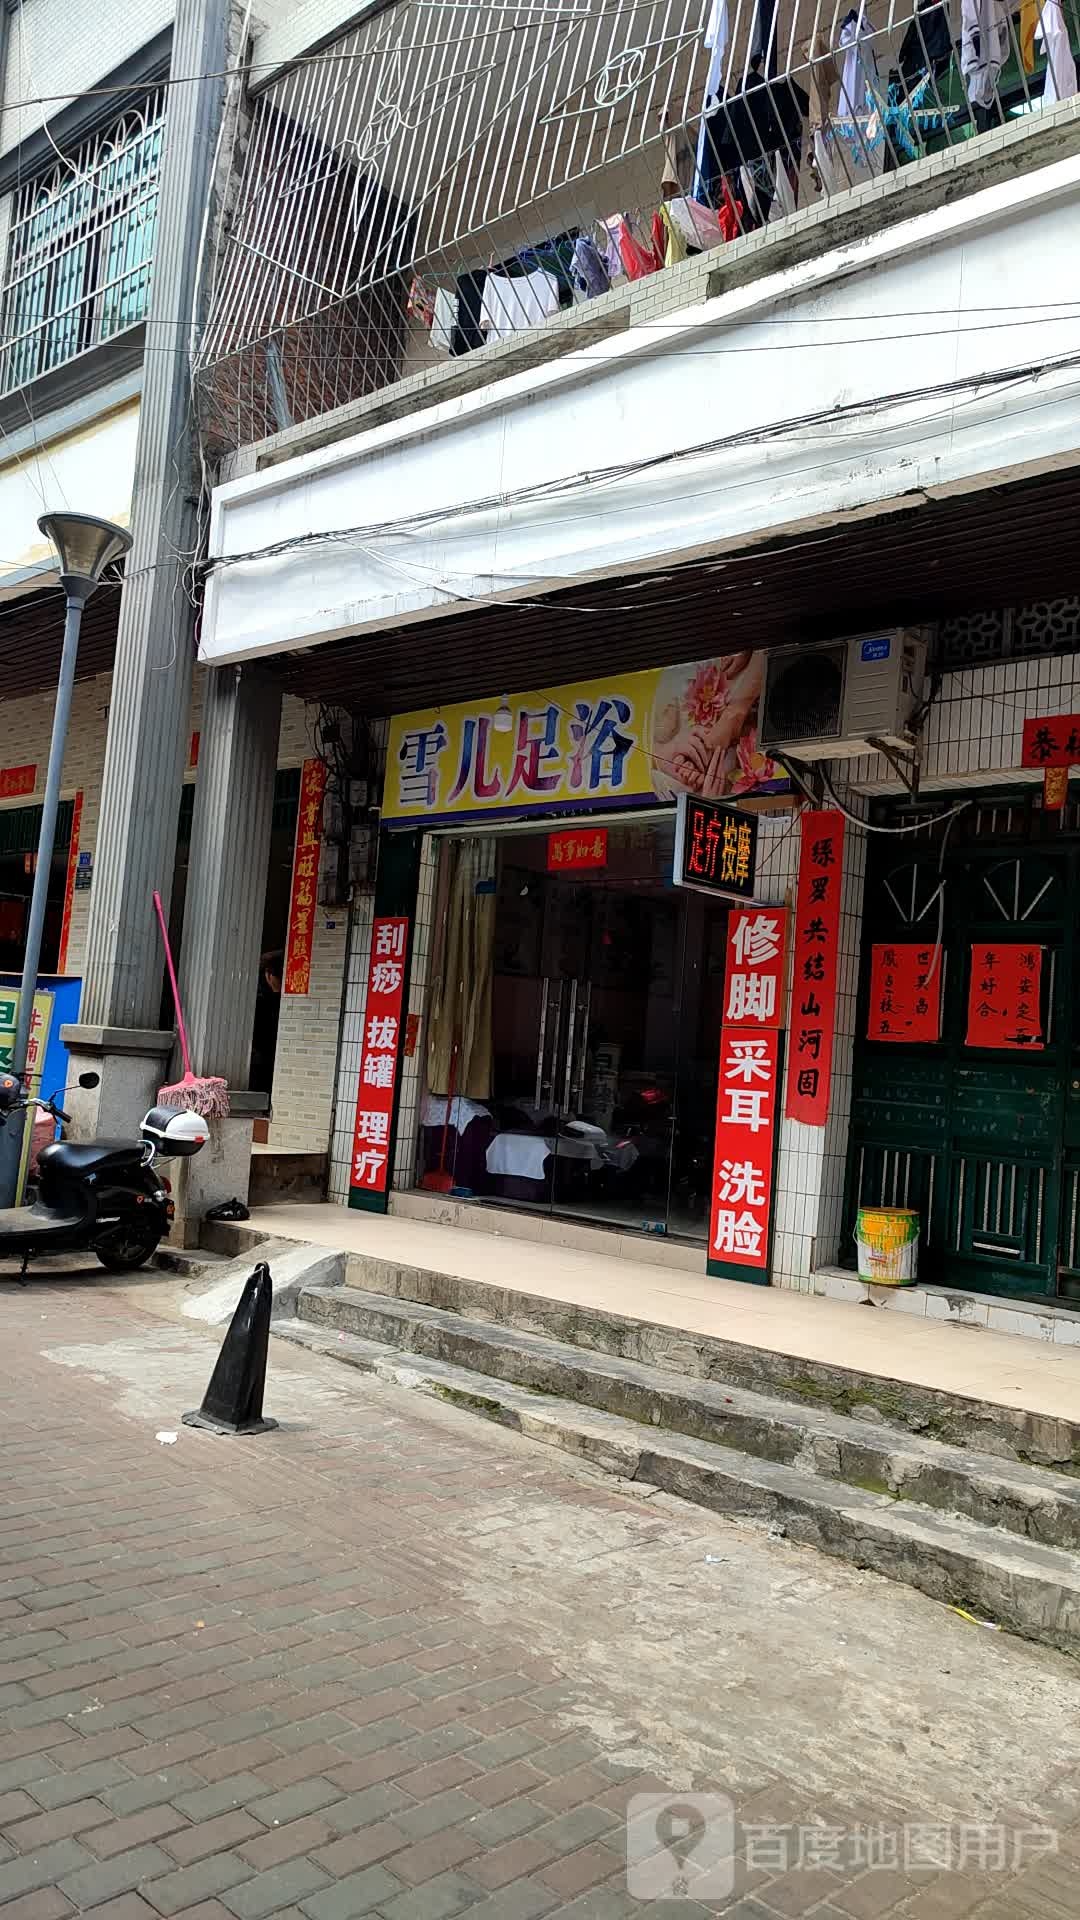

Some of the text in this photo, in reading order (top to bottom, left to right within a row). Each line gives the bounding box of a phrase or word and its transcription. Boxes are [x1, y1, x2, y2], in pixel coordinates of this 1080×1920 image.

[398, 698, 635, 806] 雪儿足浴
[371, 923, 405, 994] 刮痧
[726, 914, 780, 1022] 修脚
[363, 1016, 397, 1088] 拔罐
[721, 1039, 771, 1133] 采耳
[354, 1110, 389, 1184] 理疗
[714, 1159, 765, 1257] 洗脸
